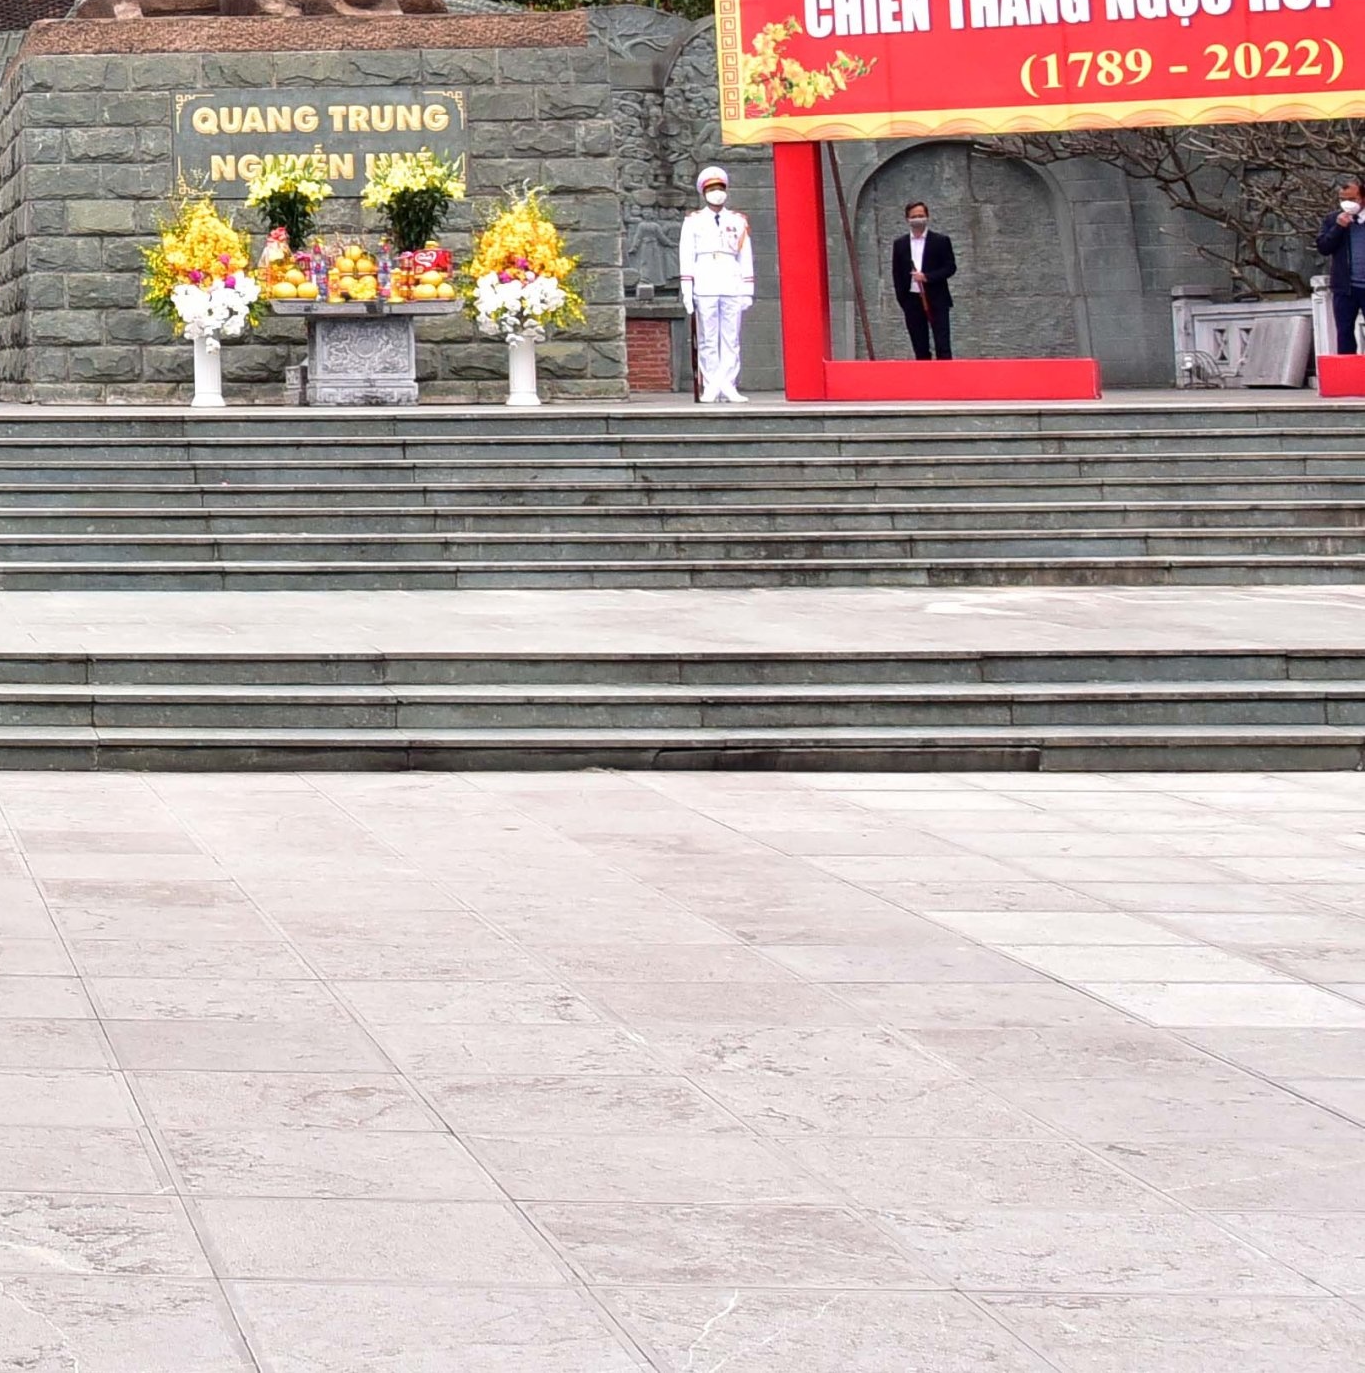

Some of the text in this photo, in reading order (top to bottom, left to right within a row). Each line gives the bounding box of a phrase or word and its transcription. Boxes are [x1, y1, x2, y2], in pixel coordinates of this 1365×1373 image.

[1020, 48, 1152, 98] (1789
[1205, 38, 1344, 84] 2022)
[192, 103, 450, 135] QUANG TRUNG
